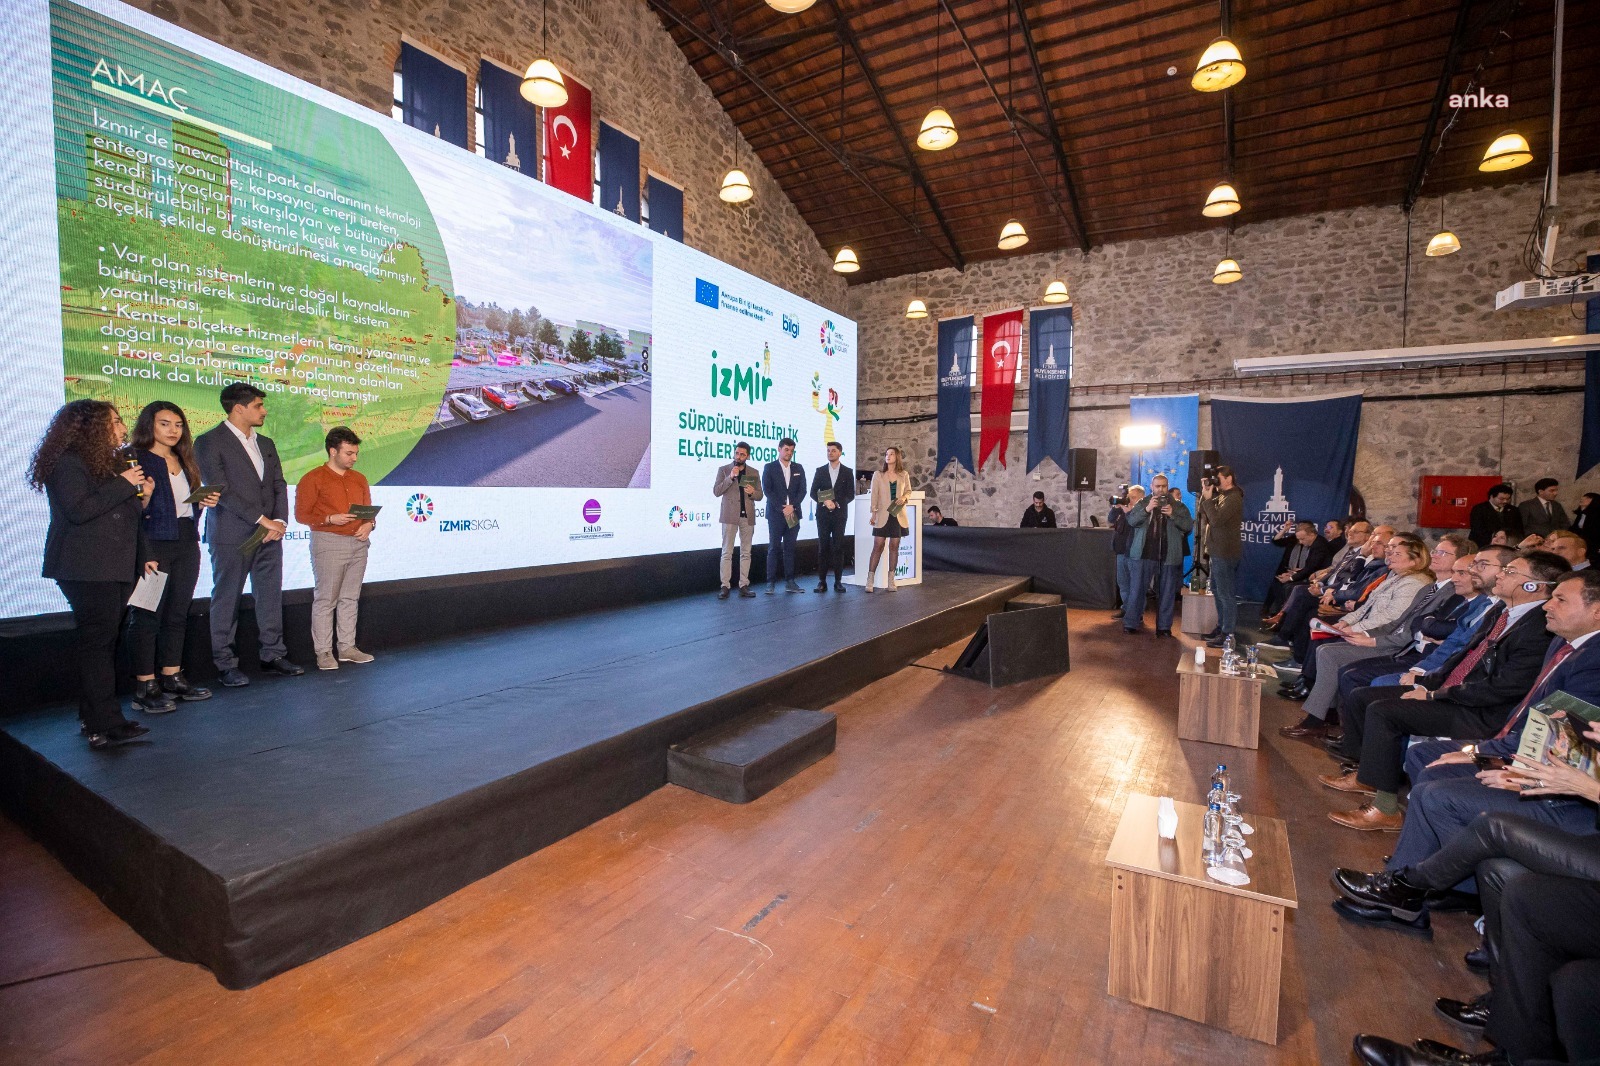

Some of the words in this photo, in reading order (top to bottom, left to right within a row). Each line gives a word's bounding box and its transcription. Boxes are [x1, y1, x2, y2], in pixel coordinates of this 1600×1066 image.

[91, 57, 188, 114] AMAÇ
[93, 136, 217, 182] entegrasyonu
[222, 171, 244, 191] ile;
[249, 178, 318, 213] kapsayıcı,
[322, 207, 357, 225] enerji
[360, 216, 400, 237] üreten,
[94, 150, 146, 180] kendi
[151, 167, 247, 208] ihtiyaçlarını
[252, 197, 323, 230] karşılayan
[326, 223, 341, 235] ve
[345, 225, 403, 252] bütünüyle
[174, 142, 263, 178] mevcuttaki
[267, 171, 300, 190] park
[304, 181, 372, 212] alanlarının
[374, 205, 422, 229] teknoloji
[95, 176, 212, 215] sürdürülebilir
[216, 204, 237, 222] bir
[241, 214, 298, 239] sistemle
[302, 228, 340, 250] küçük
[343, 242, 357, 255] ve
[360, 247, 396, 266] büyük
[95, 194, 153, 220] ölçekli
[159, 211, 217, 235] şekilde
[221, 224, 329, 264] dönüştürülmesi
[98, 259, 236, 300] bütünleştirilerek
[240, 292, 330, 318] sürdürülebilir
[333, 306, 350, 322] bir
[353, 314, 389, 329] sistem
[98, 285, 204, 315] yaratılması,
[112, 243, 147, 264] Var
[151, 253, 190, 274] olan
[195, 264, 276, 292] sistemlerin
[279, 284, 295, 295] ve
[299, 284, 338, 304] doğal
[342, 292, 410, 318] kaynakların
[100, 320, 156, 343] doğal
[162, 328, 227, 351] hayatla
[231, 342, 351, 369] entegrasyonunun
[354, 358, 420, 380] gözetilmesi,
[115, 303, 181, 327] Kentsel
[187, 312, 244, 336] ölçekte
[248, 324, 325, 349] hizmetlerin
[328, 337, 363, 356] kamu
[366, 347, 416, 364] yararının
[418, 356, 431, 366] ve
[782, 313, 800, 339] bilgi
[101, 359, 161, 380] olarak
[167, 366, 190, 383] da
[196, 369, 285, 393] kullalması
[289, 383, 382, 404] amaçlanmıştır.
[117, 342, 163, 363] Proje
[168, 349, 255, 373] alanlarının
[258, 361, 292, 376] afet
[291, 365, 355, 384] toplanma
[359, 375, 403, 391] alanları
[678, 408, 799, 443] SÜRDÜRÜLEBİLİRLİK
[749, 445, 797, 463] ROGRI
[683, 511, 711, 522] SÜGEP
[1258, 511, 1296, 522] İZMİR
